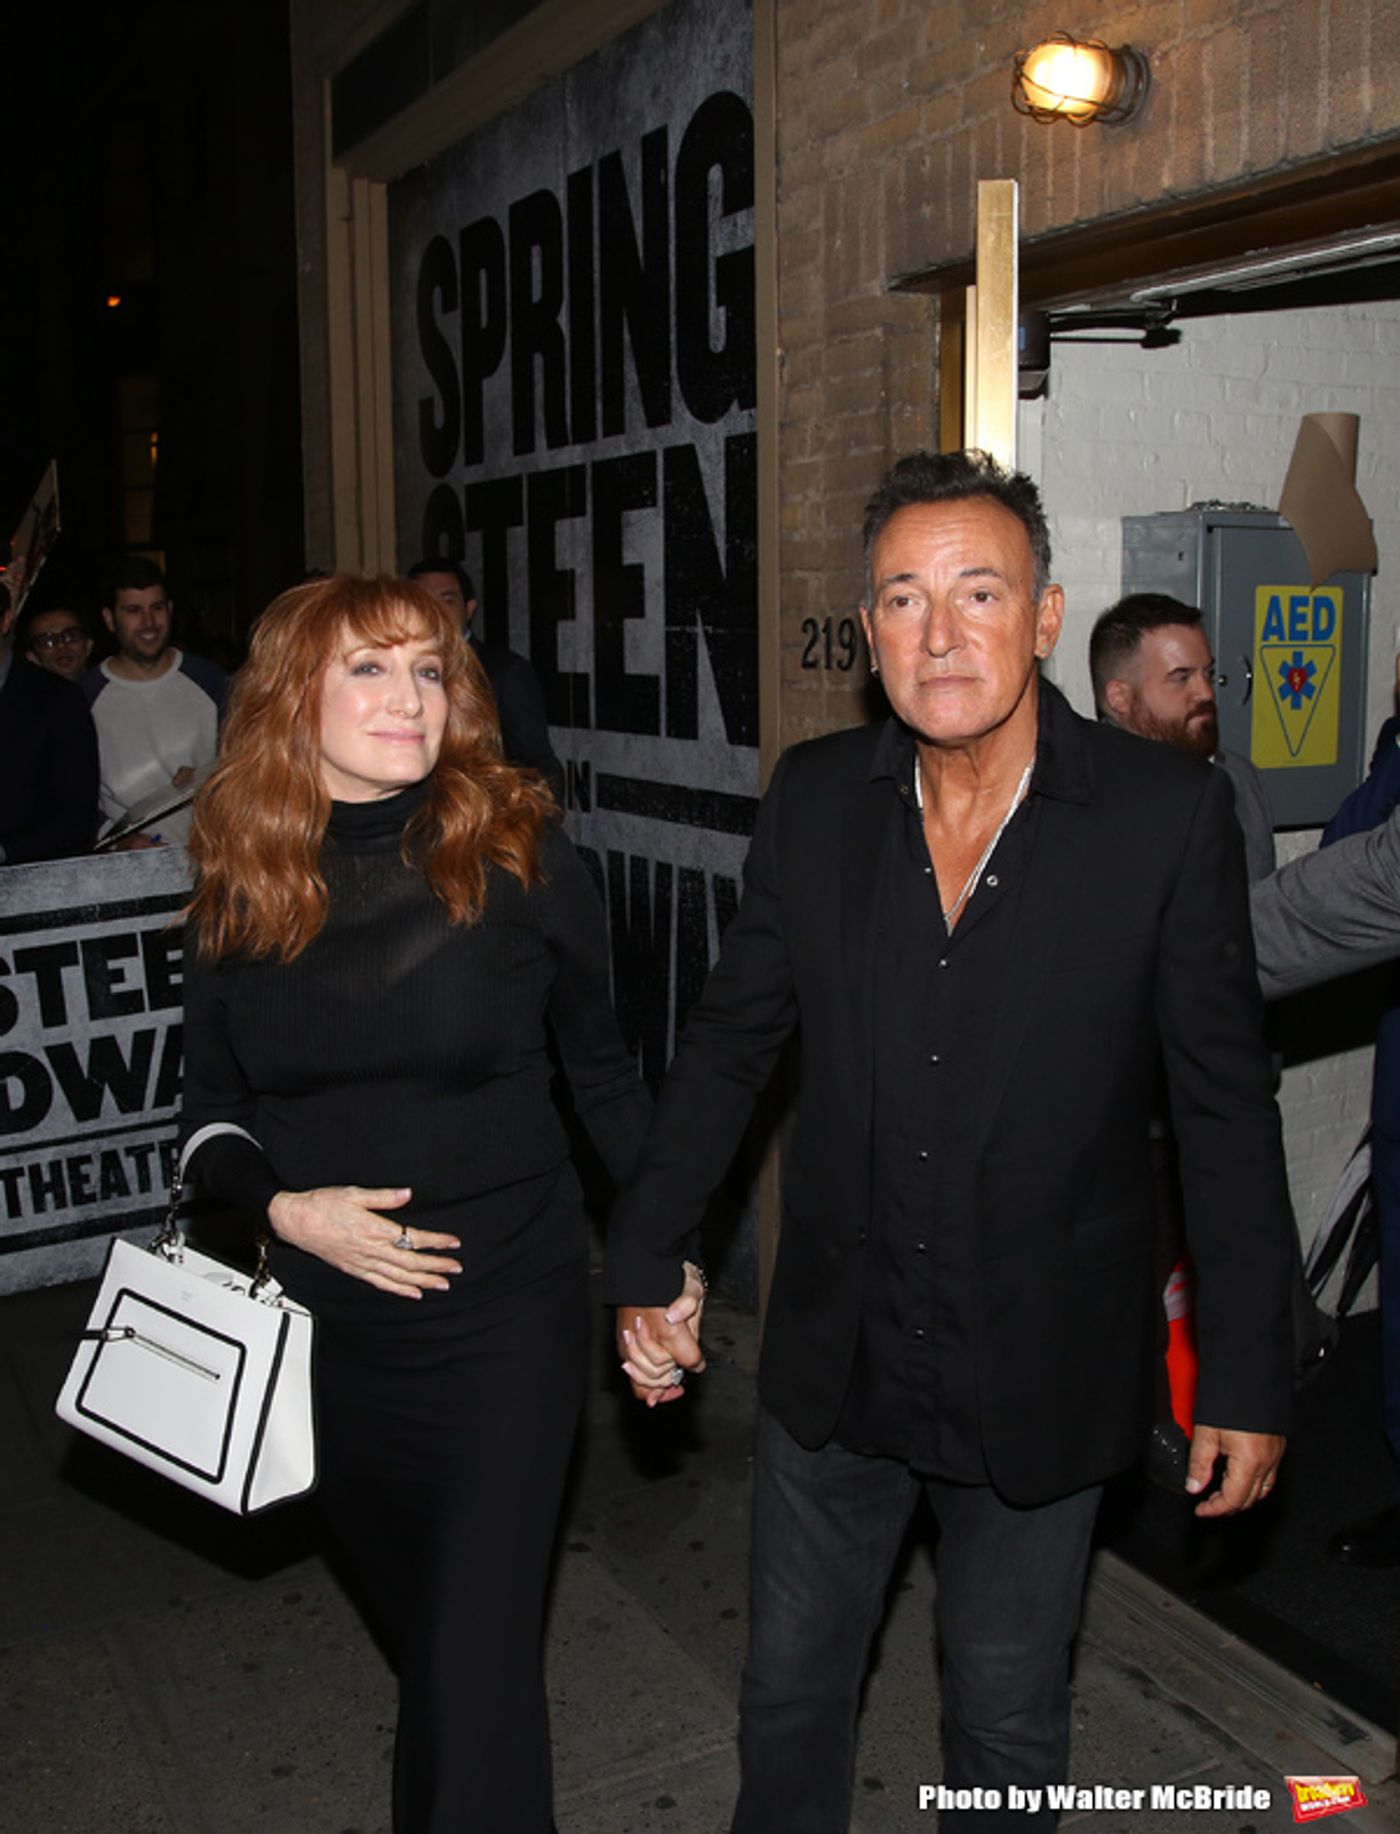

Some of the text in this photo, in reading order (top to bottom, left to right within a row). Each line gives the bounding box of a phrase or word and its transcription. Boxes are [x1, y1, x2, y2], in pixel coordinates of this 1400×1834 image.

[416, 91, 757, 478] SPRING
[801, 616, 856, 671] 219
[1261, 595, 1336, 641] AED
